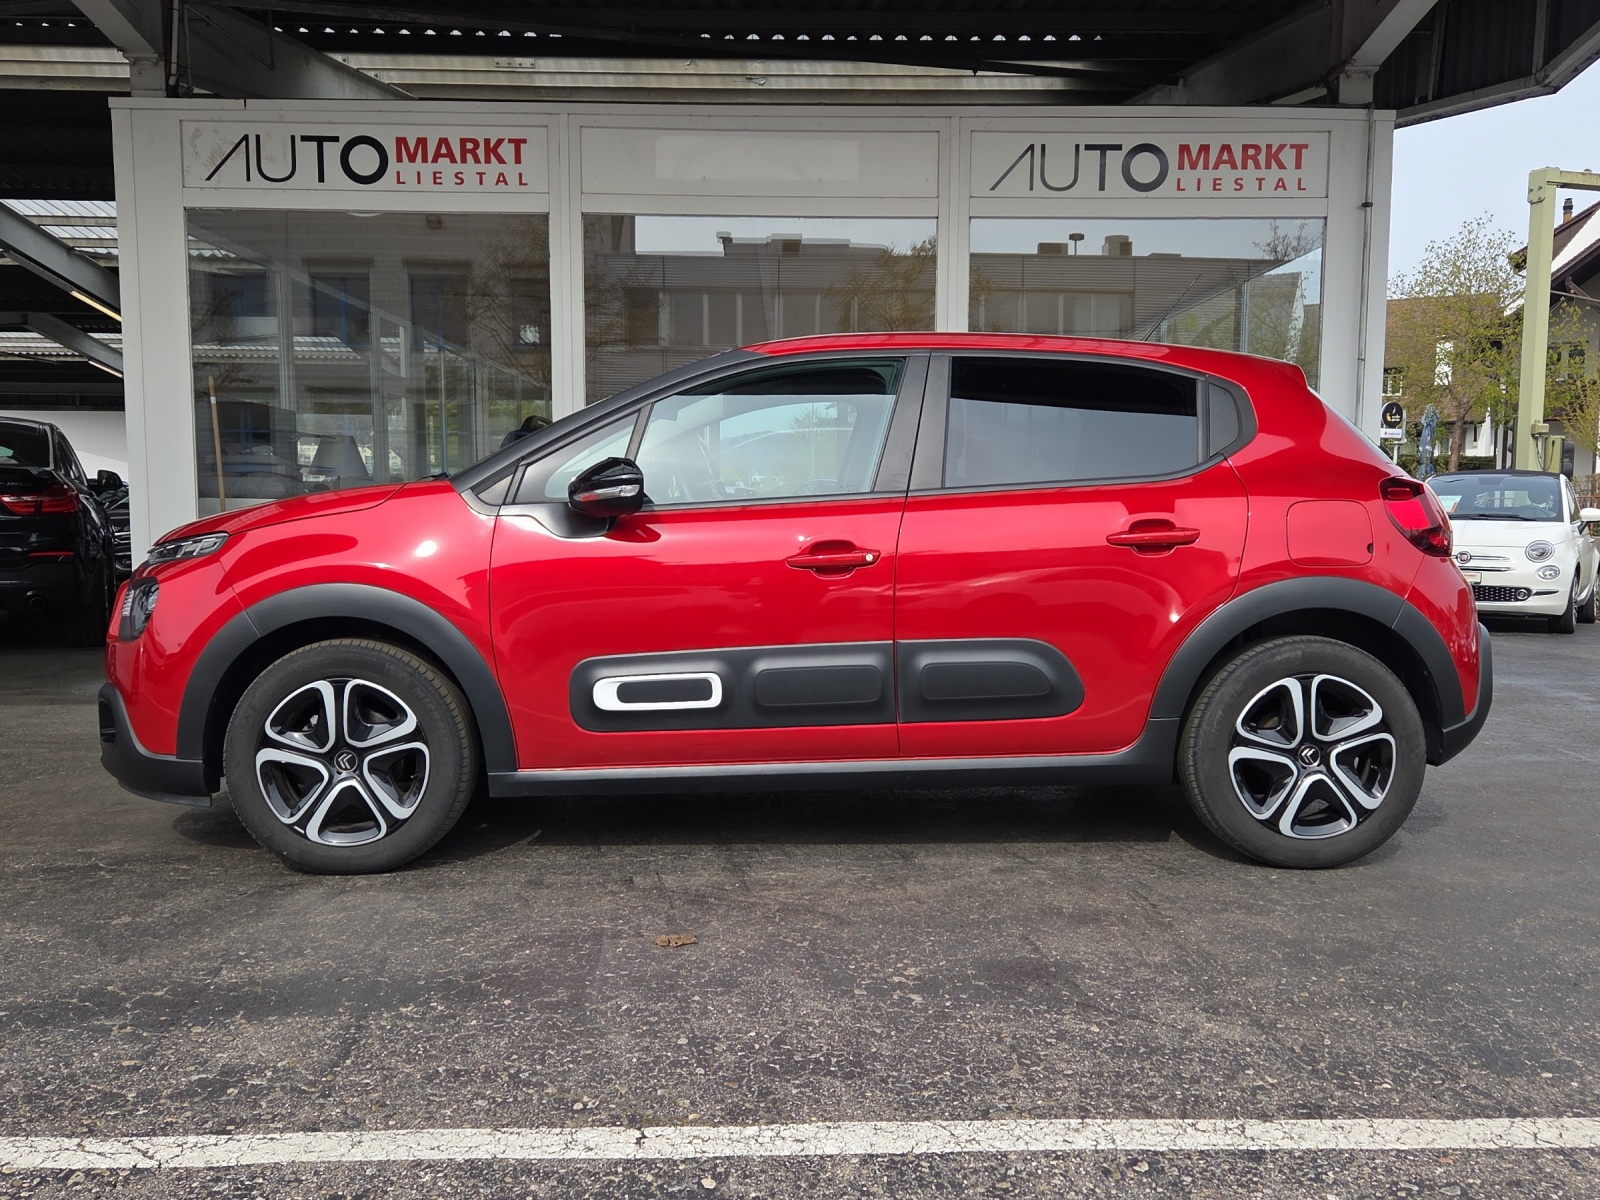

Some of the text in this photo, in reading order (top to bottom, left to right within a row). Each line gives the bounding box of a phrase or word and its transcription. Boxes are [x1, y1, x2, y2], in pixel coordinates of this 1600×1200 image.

[204, 133, 528, 185] AUTO MARKT
[989, 142, 1309, 193] AUTO MARKT
[396, 170, 529, 187] LIESTAL
[1176, 177, 1308, 192] LIESTAL
